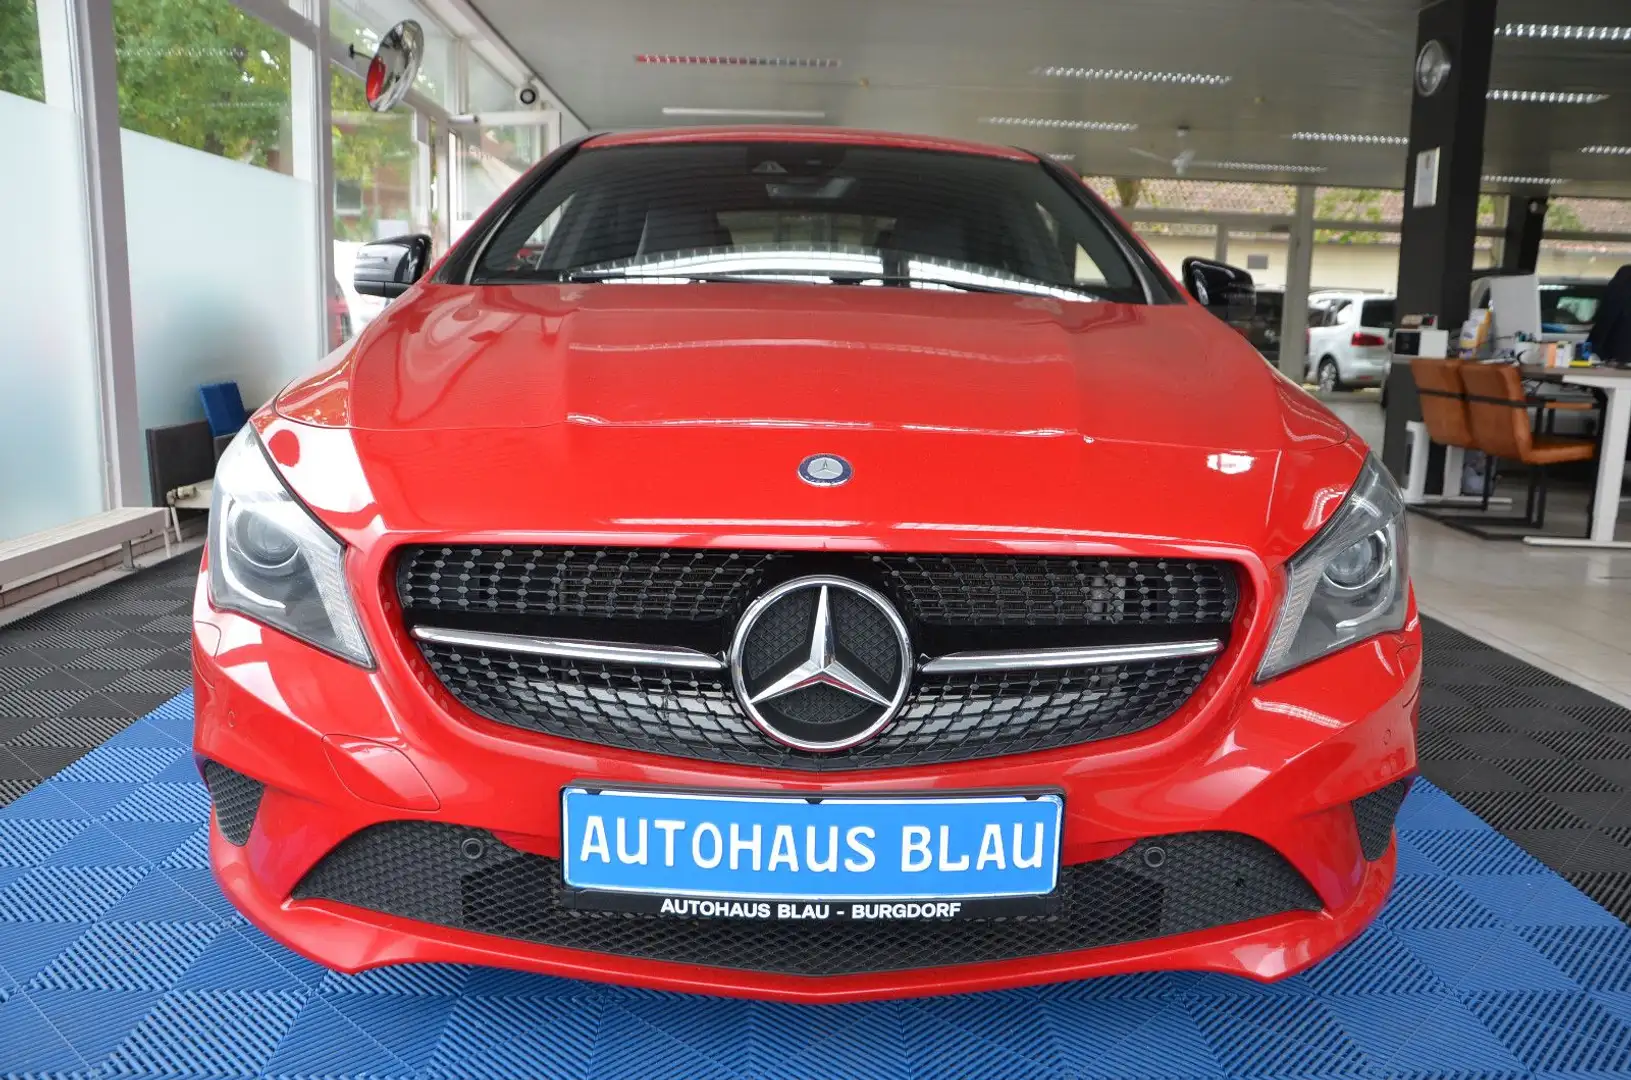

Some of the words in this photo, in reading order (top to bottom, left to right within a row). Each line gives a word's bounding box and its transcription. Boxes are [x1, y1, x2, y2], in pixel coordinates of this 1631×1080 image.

[580, 815, 876, 873] AUTOHAUS
[901, 822, 1044, 873] BLAU
[660, 898, 771, 918] AUTOHAUS
[777, 903, 830, 919] BLAU
[851, 902, 962, 919] BURGDORF
